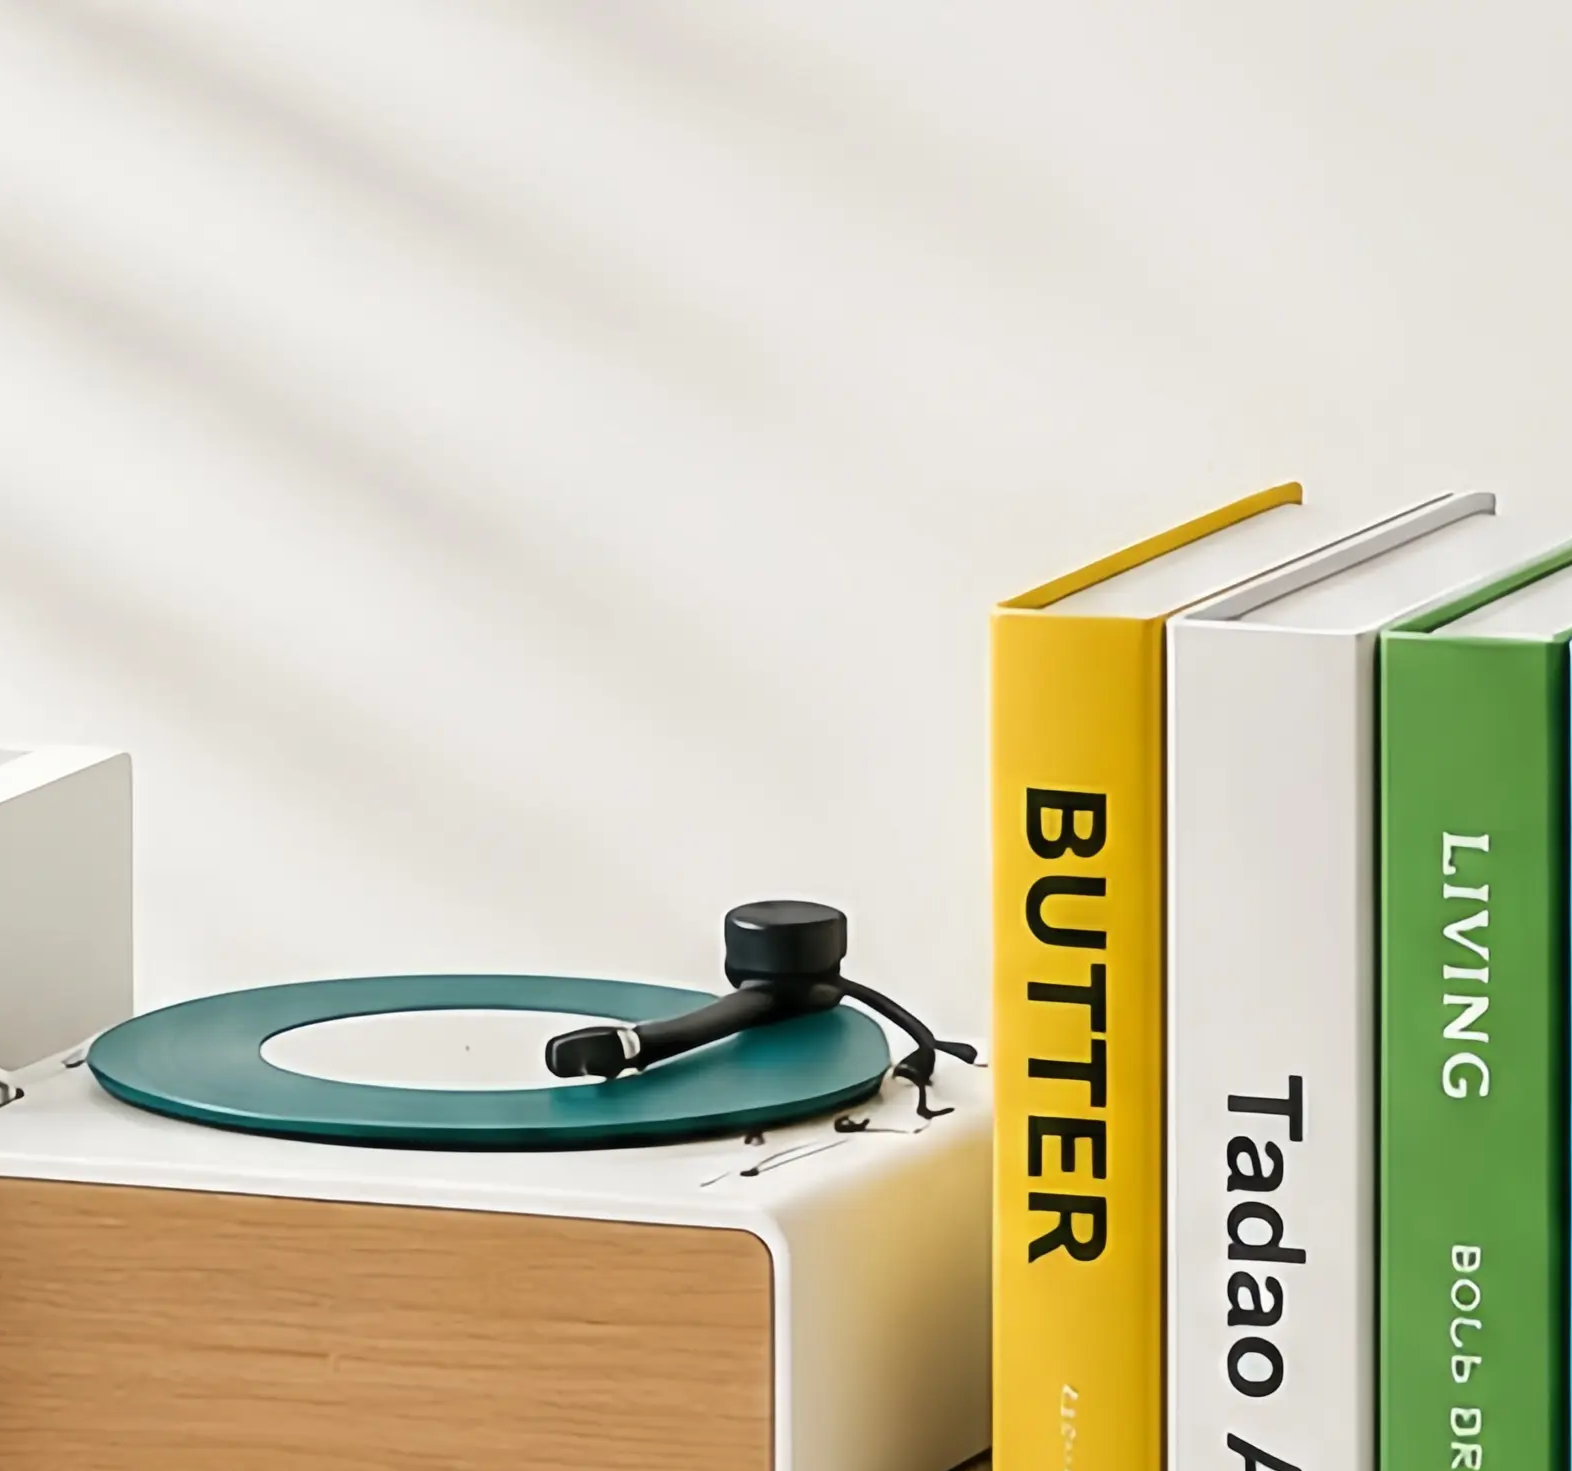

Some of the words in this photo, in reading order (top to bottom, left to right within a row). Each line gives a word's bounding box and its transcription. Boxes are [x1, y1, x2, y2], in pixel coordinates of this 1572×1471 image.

[1025, 787, 1108, 1263] BUTTER
[1441, 831, 1490, 1099] LIVING
[1226, 1074, 1307, 1398] Tadao
